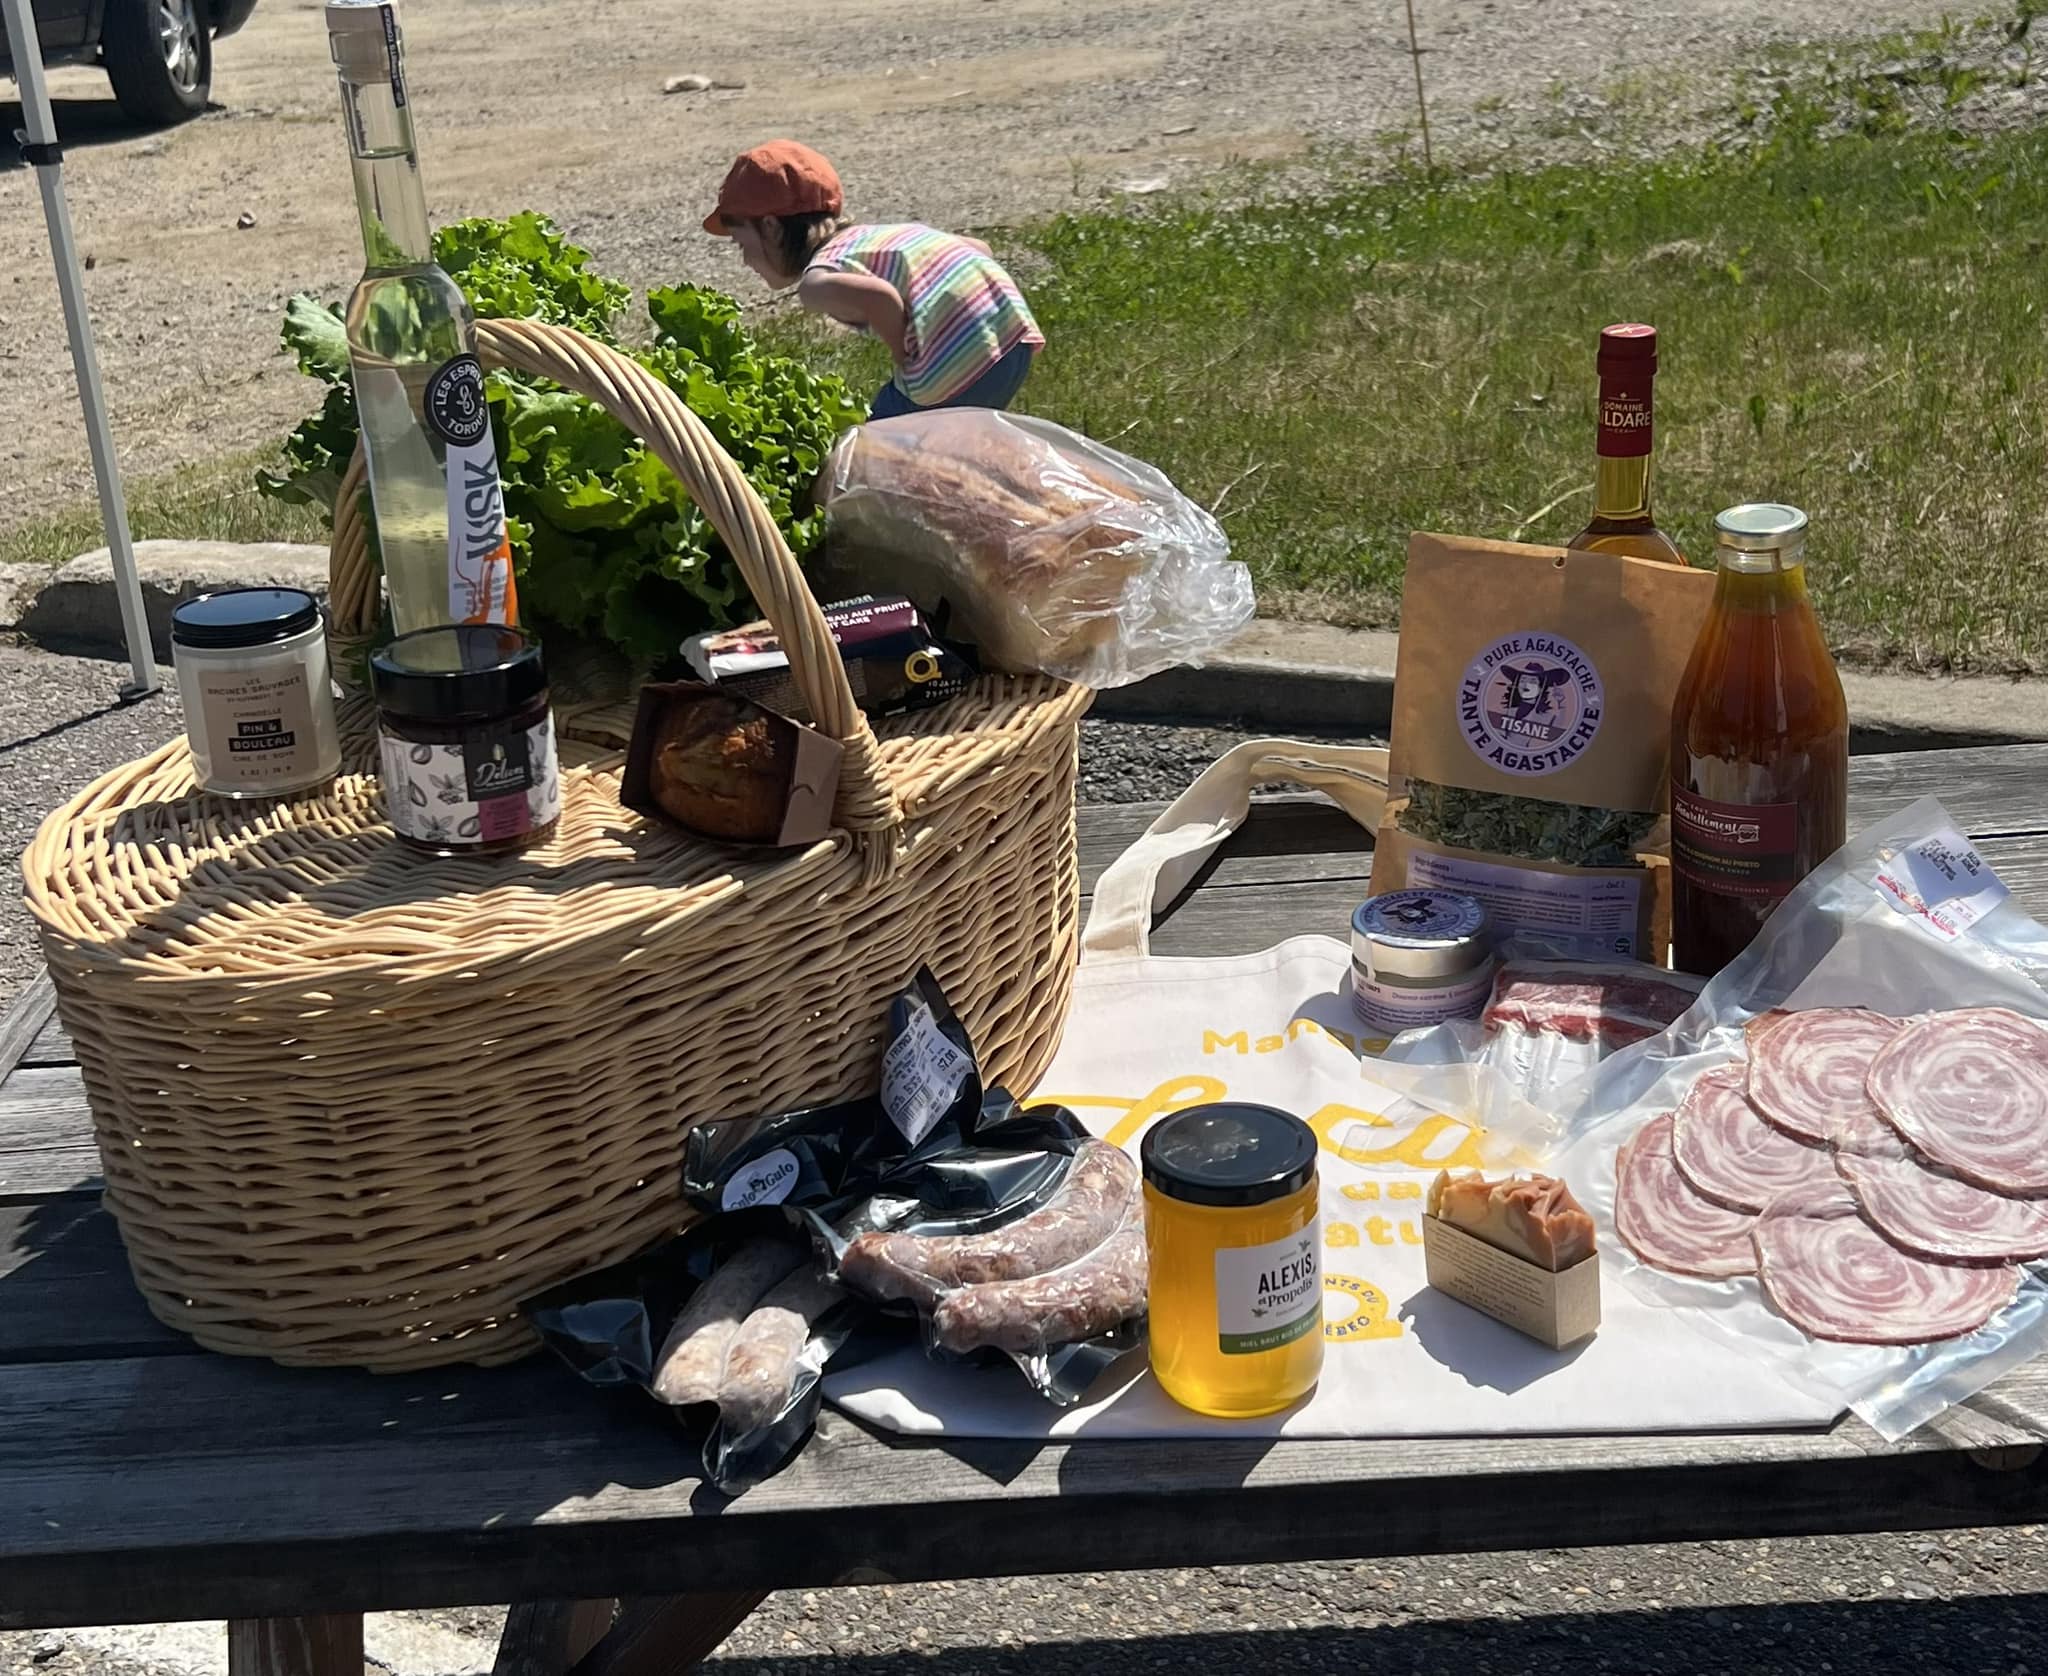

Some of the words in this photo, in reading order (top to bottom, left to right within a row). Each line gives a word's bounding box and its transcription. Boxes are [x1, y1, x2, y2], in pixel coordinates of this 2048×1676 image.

[436, 380, 453, 405] LES
[1604, 401, 1644, 412] DOMAINE
[1601, 410, 1651, 428] ILDARE
[827, 612, 849, 623] EAU
[852, 608, 874, 620] AUX
[875, 600, 912, 615] FRUITS
[842, 616, 871, 628] CAKE
[1484, 640, 1522, 667] PURE
[1526, 638, 1596, 693] AGASTACHE
[242, 724, 264, 734] PIN
[1462, 680, 1491, 749] TANTE
[1488, 707, 1600, 771] AGASTACHE
[1501, 716, 1550, 739] TISANE
[232, 735, 291, 750] BOULEAU
[1203, 1019, 1389, 1055] Mange
[765, 1163, 794, 1186] Gulo
[1340, 1180, 1422, 1201] da
[1324, 1214, 1424, 1248] atu
[1267, 1277, 1312, 1307] Propolis
